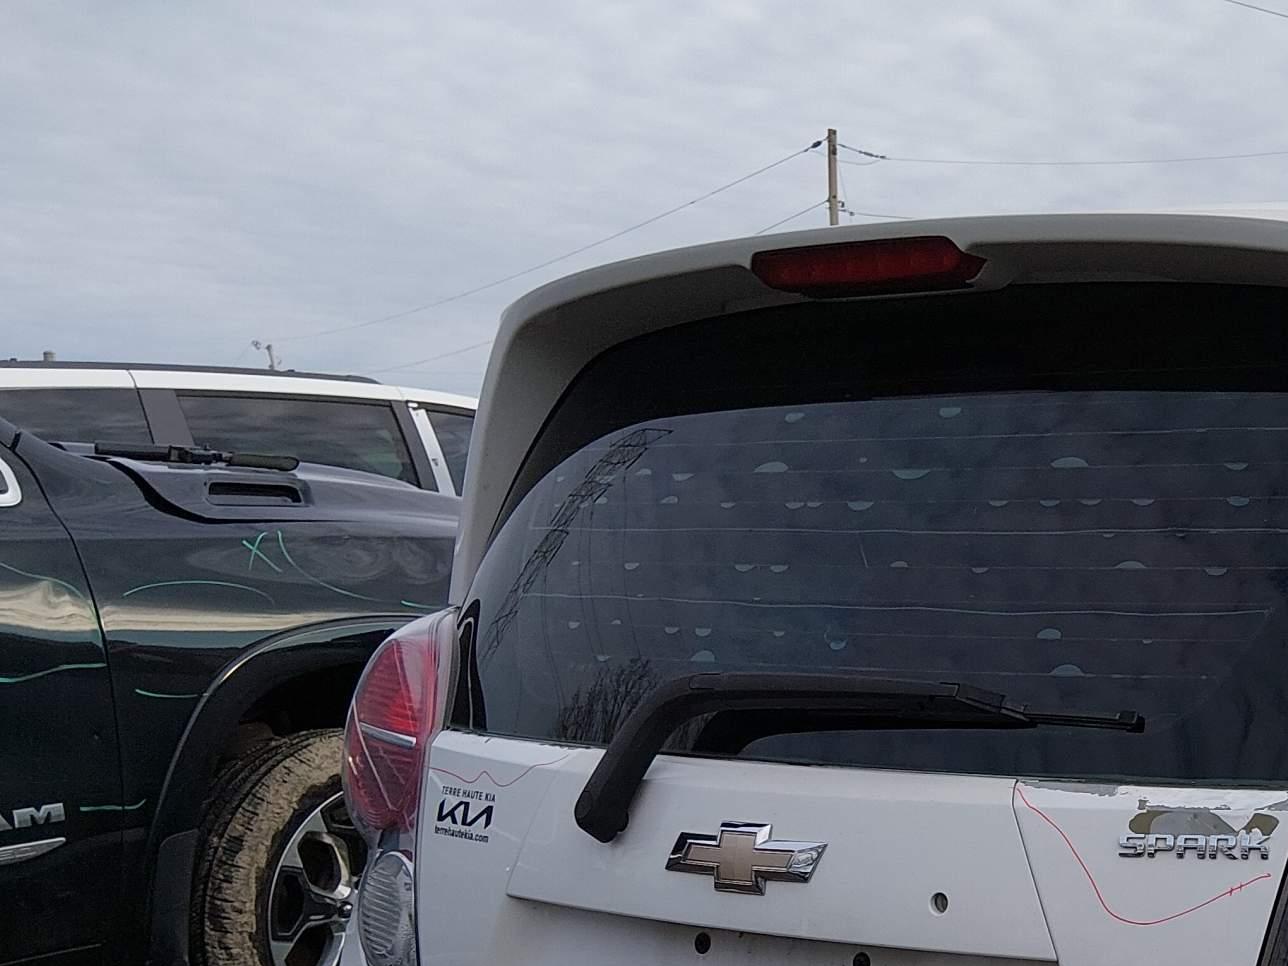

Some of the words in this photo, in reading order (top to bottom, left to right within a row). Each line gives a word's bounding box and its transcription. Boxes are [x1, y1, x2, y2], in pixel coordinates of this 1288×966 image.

[442, 786, 461, 797] TERRE
[462, 790, 483, 800] HAUTE
[485, 793, 496, 802] KIA
[434, 825, 488, 843] terrehautekia.com
[1118, 833, 1271, 860] SPARK
